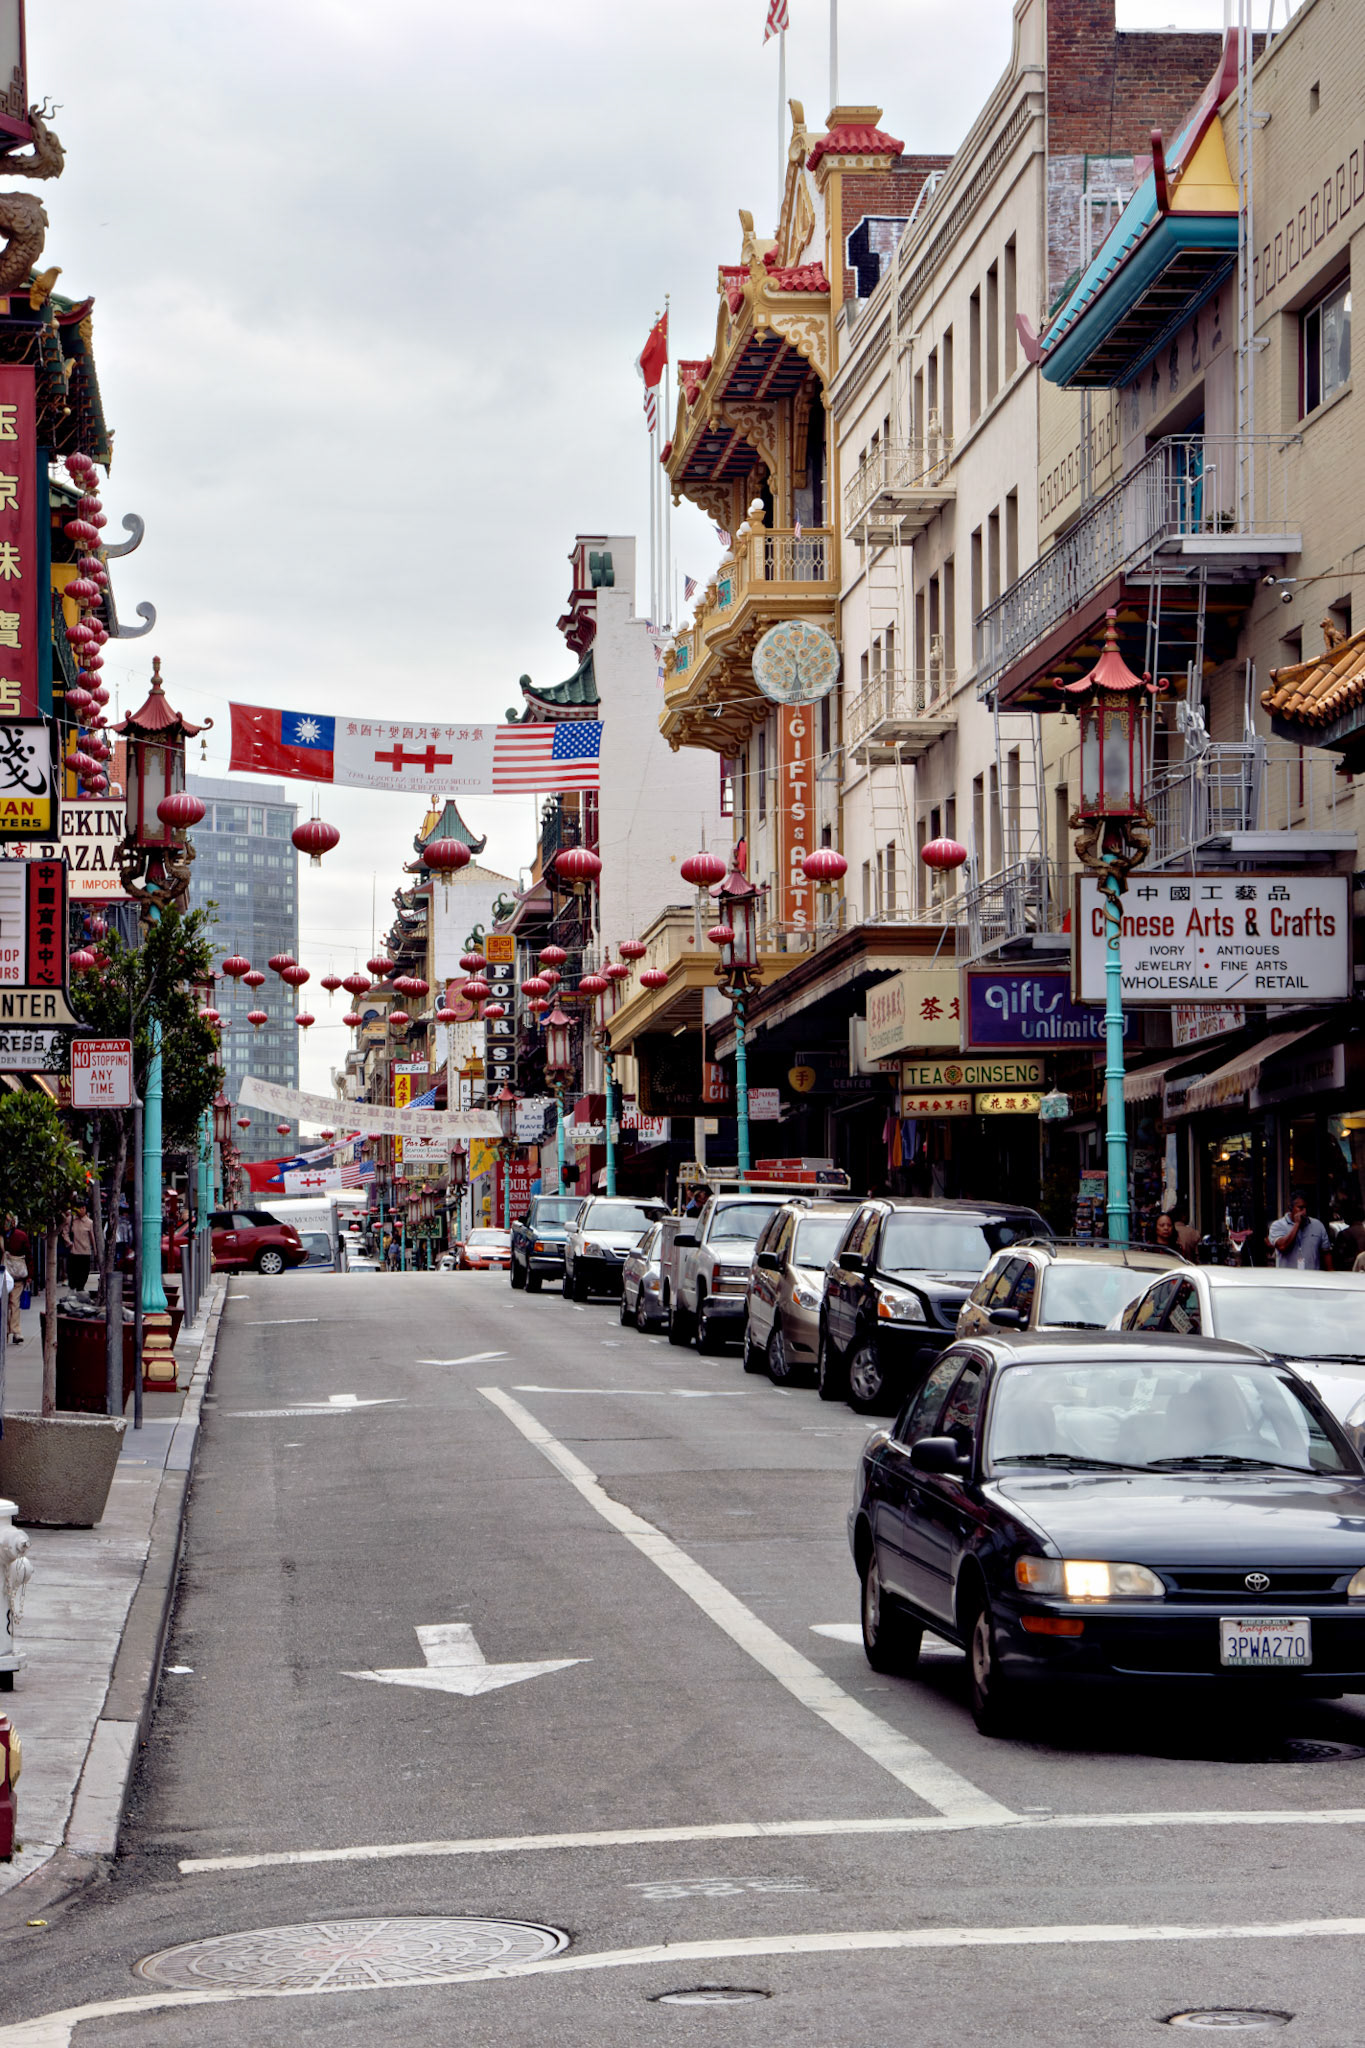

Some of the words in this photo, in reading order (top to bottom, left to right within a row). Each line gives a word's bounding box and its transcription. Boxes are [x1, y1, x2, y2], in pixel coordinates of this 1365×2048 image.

[789, 719, 807, 820] GIFTS
[61, 810, 126, 836] EKIN
[789, 846, 808, 927] ARTS
[1137, 885, 1291, 901] 中國工藝品
[1091, 907, 1175, 937] Cnese
[1185, 907, 1235, 937] Arts
[1245, 907, 1261, 937] &
[1270, 907, 1336, 937] Crafts
[1150, 945, 1185, 955] IVORY
[1216, 945, 1280, 956] ANTIQUES
[1135, 961, 1192, 971] JEWELRY
[1221, 961, 1248, 970] FINE
[1255, 961, 1288, 970] ARTS
[1121, 976, 1218, 989] WHOLESALE
[1255, 976, 1309, 988] RETAIL
[984, 980, 1063, 1021] gifts
[77, 1042, 126, 1051] TOW-AWAY
[74, 1052, 90, 1067] NO
[91, 1055, 128, 1066] STOPPING
[91, 1070, 113, 1080] ANY
[908, 1067, 943, 1085] TEA
[964, 1065, 1040, 1083] GINSENG
[89, 1083, 115, 1094] TIME
[621, 1112, 663, 1134] Gallery
[569, 1128, 598, 1136] CLAY
[1239, 1625, 1294, 1635] California
[1228, 1637, 1305, 1658] 3PWA270
